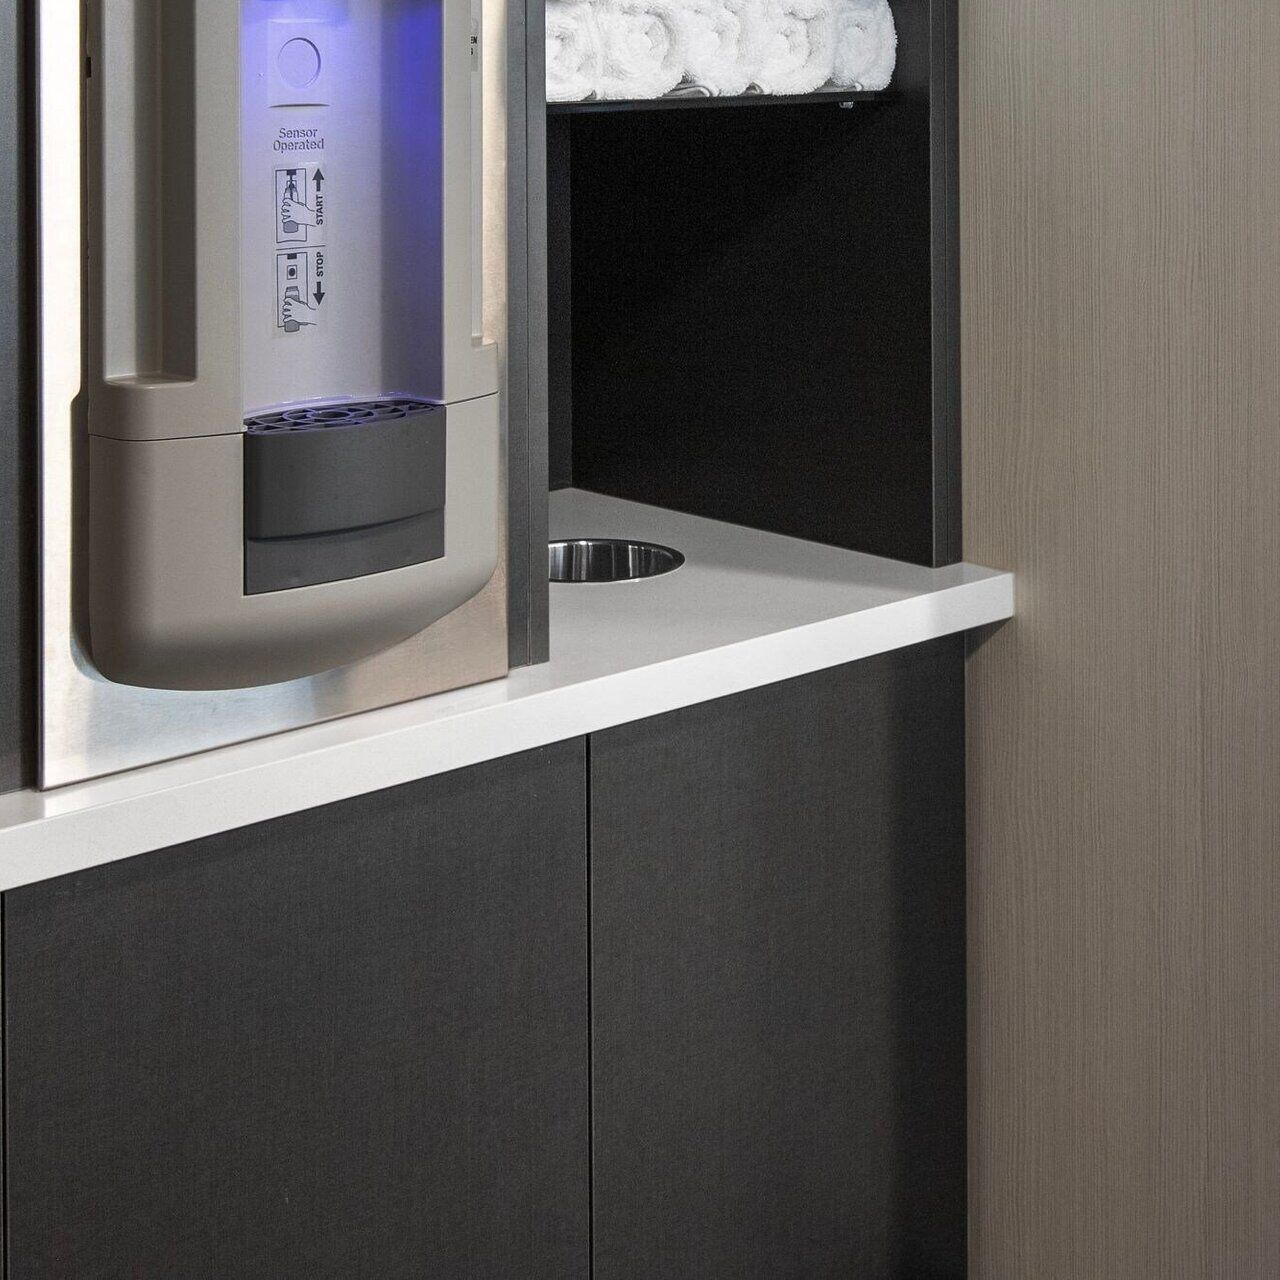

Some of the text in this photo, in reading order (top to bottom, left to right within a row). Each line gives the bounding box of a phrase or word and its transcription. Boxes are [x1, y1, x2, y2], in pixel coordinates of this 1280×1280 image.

[278, 127, 318, 138] Sensor
[273, 138, 324, 154] Operated
[315, 194, 324, 226] START
[316, 251, 324, 277] STOP
